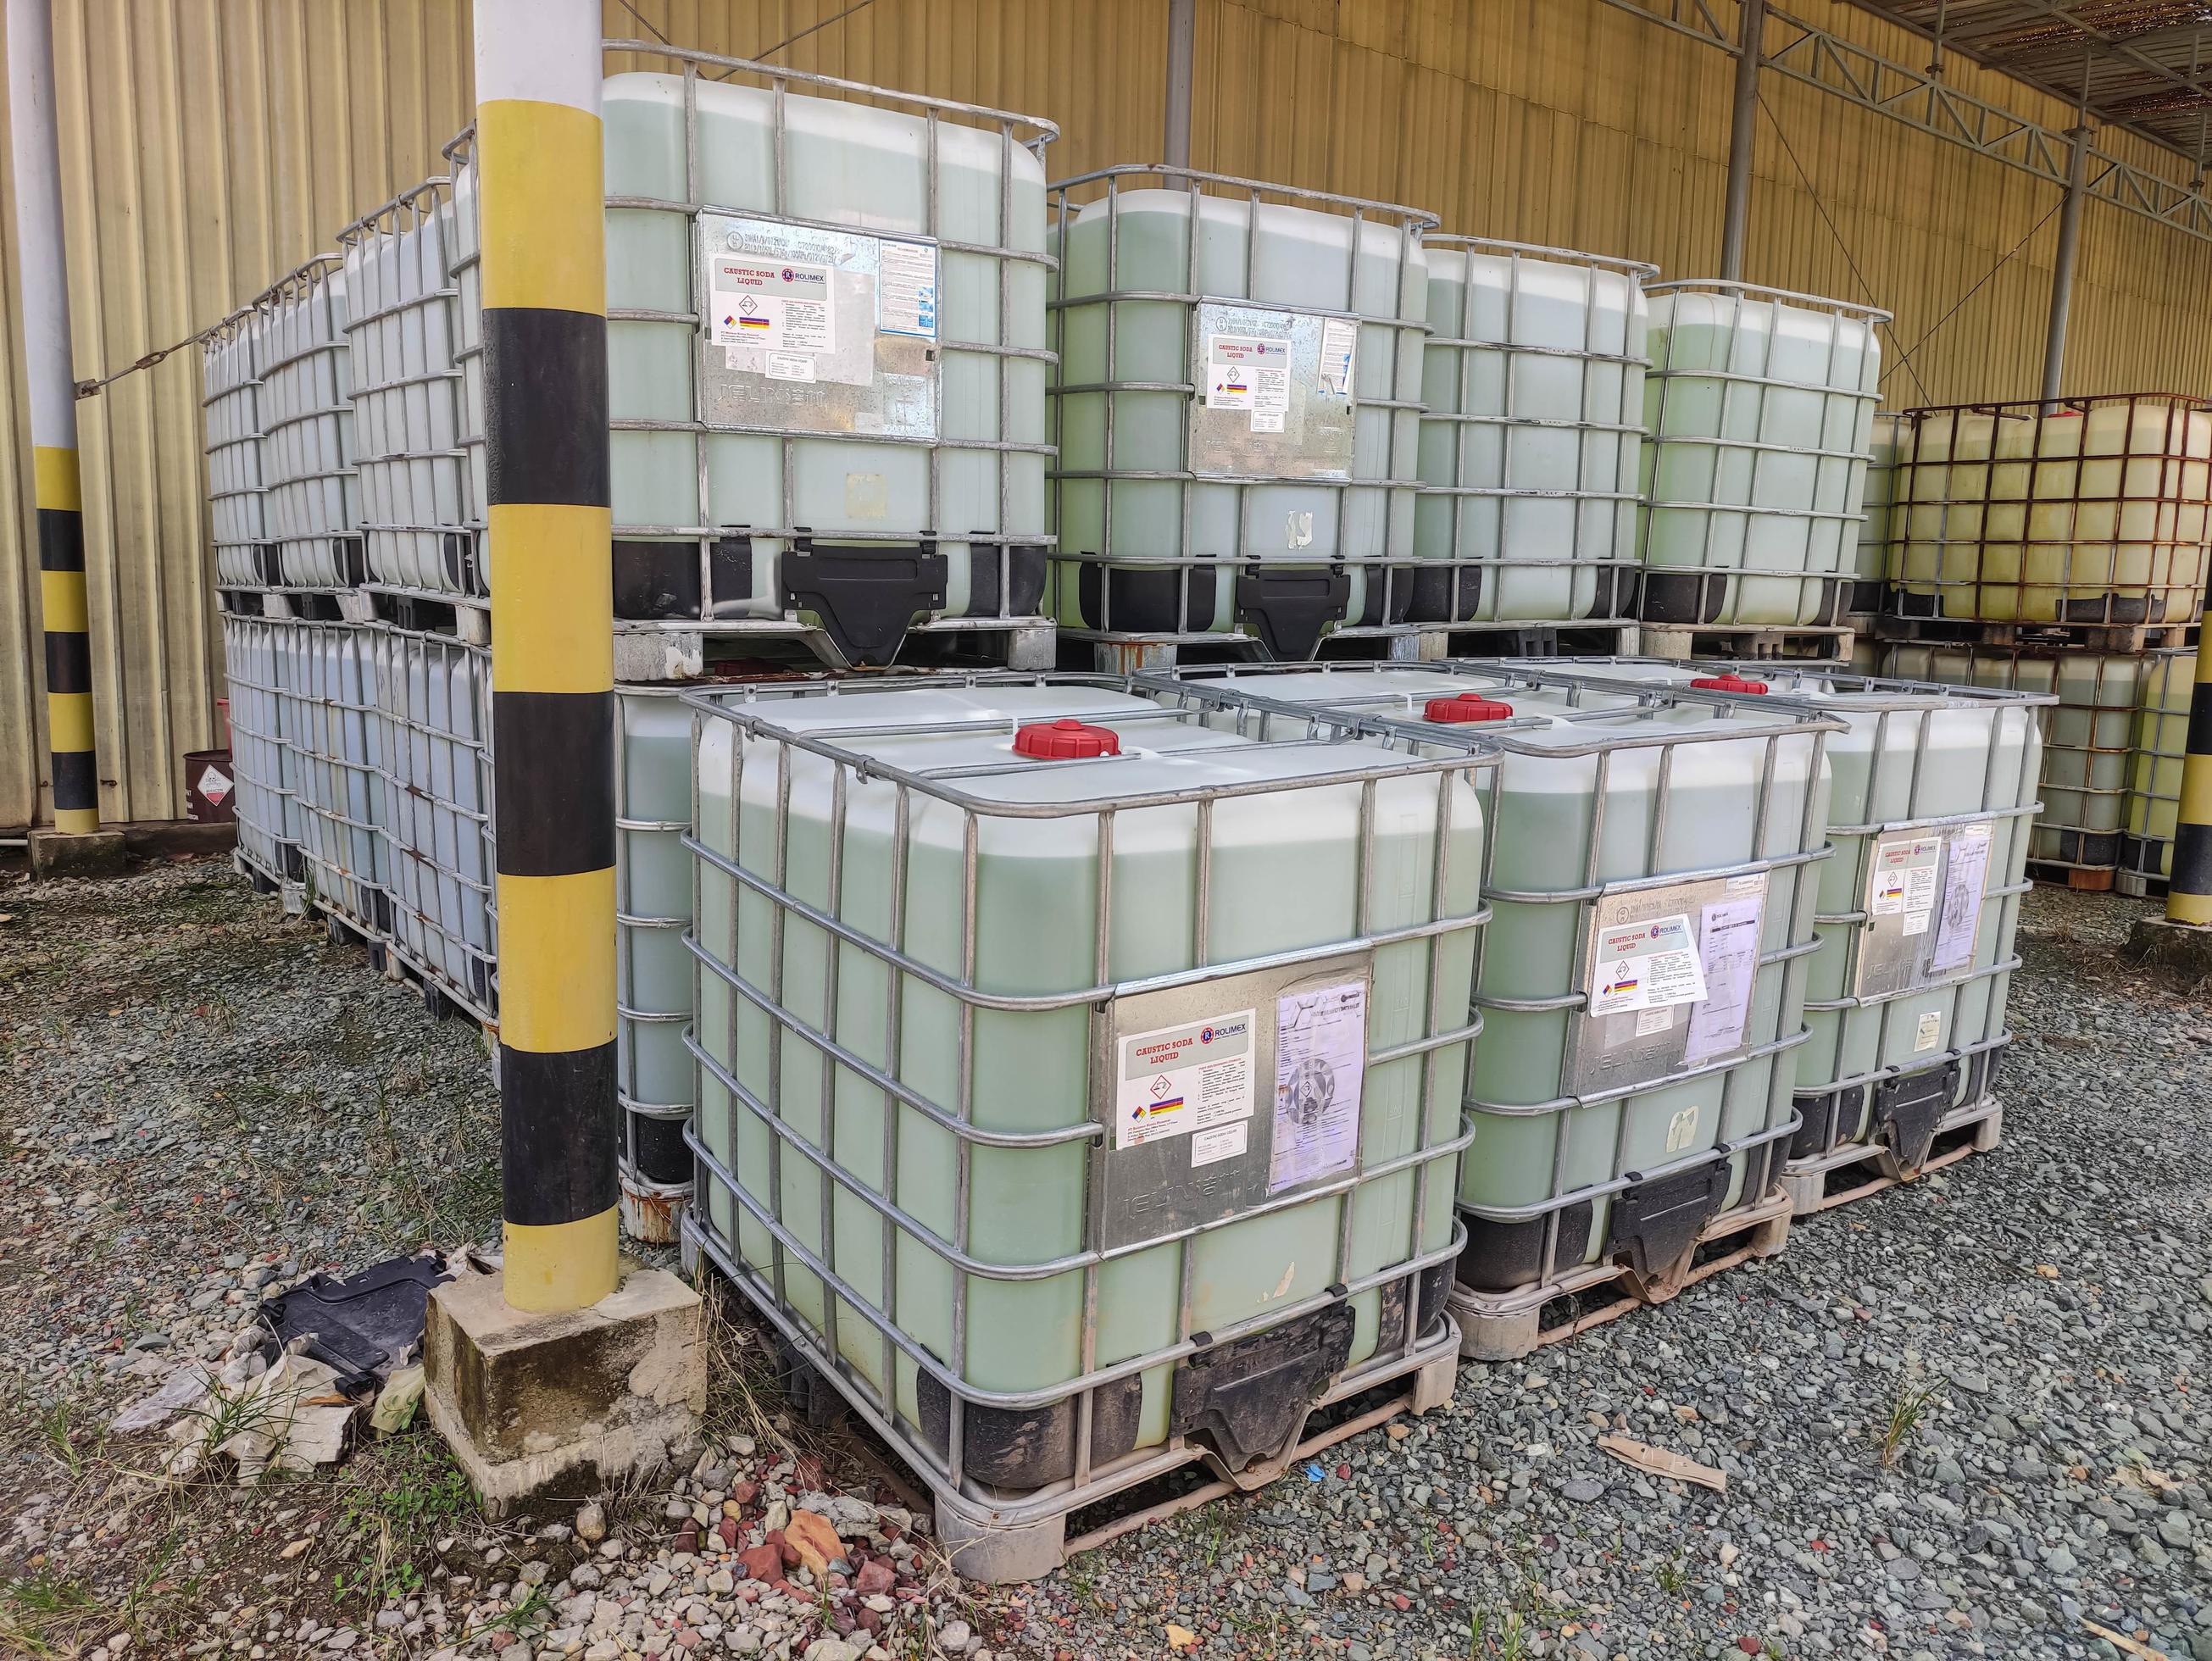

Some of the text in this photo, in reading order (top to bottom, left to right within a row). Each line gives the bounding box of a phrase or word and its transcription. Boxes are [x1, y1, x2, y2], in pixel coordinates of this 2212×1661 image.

[724, 268, 755, 276] CAUSTIC
[795, 273, 824, 281] ROLIMEX
[1659, 925, 1681, 934] ROLIMEX
[1608, 935, 1631, 945] CAUSTIC
[1617, 943, 1637, 952] LIQUID
[1214, 1024, 1246, 1037] ROLIMEX
[1136, 1038, 1192, 1056] CAUSTIC SODA
[1150, 1052, 1179, 1064] LIQUID
